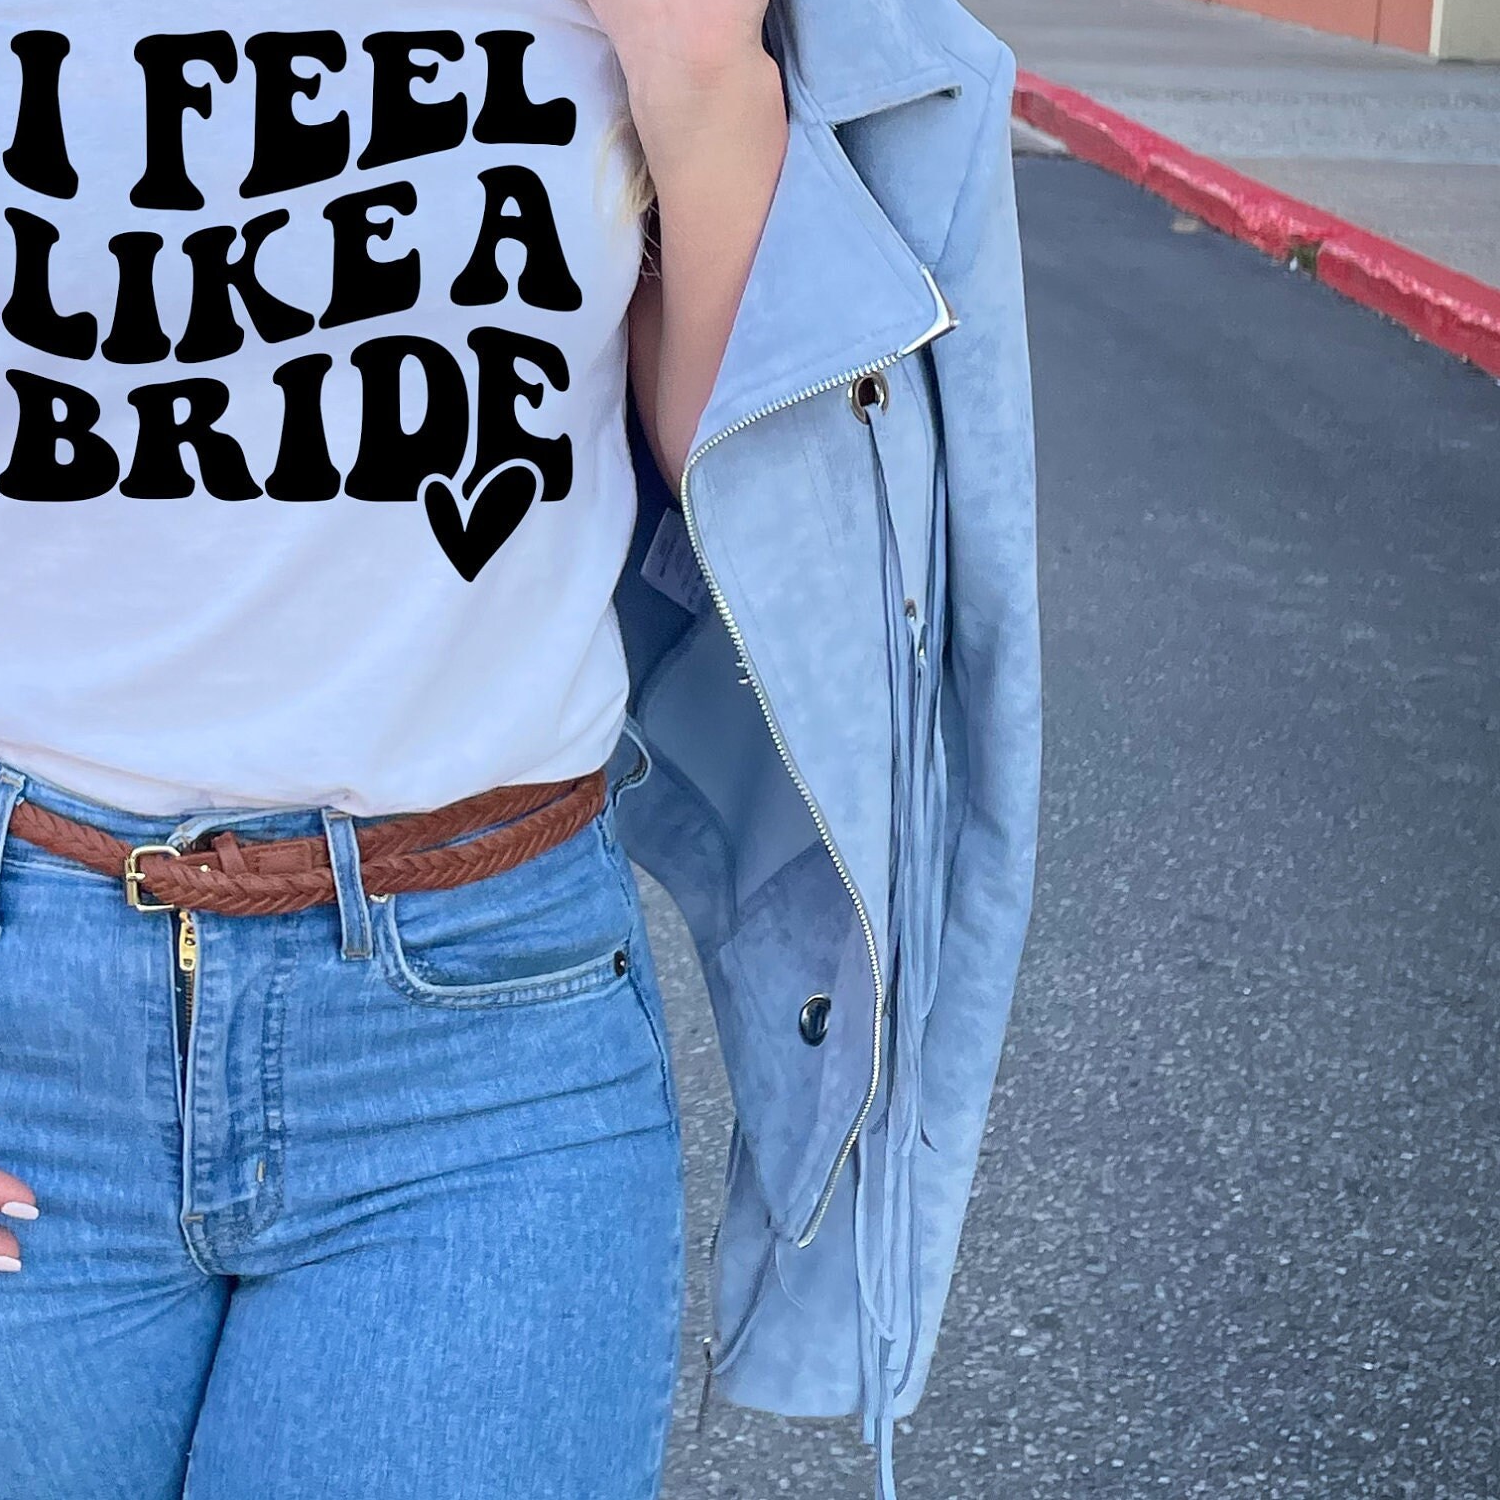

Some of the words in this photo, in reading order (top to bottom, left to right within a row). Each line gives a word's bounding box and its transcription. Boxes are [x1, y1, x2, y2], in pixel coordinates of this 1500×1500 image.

[3, 30, 78, 199] I
[130, 30, 577, 211] FEEL
[2, 181, 421, 364] LIKE
[450, 166, 583, 311] A
